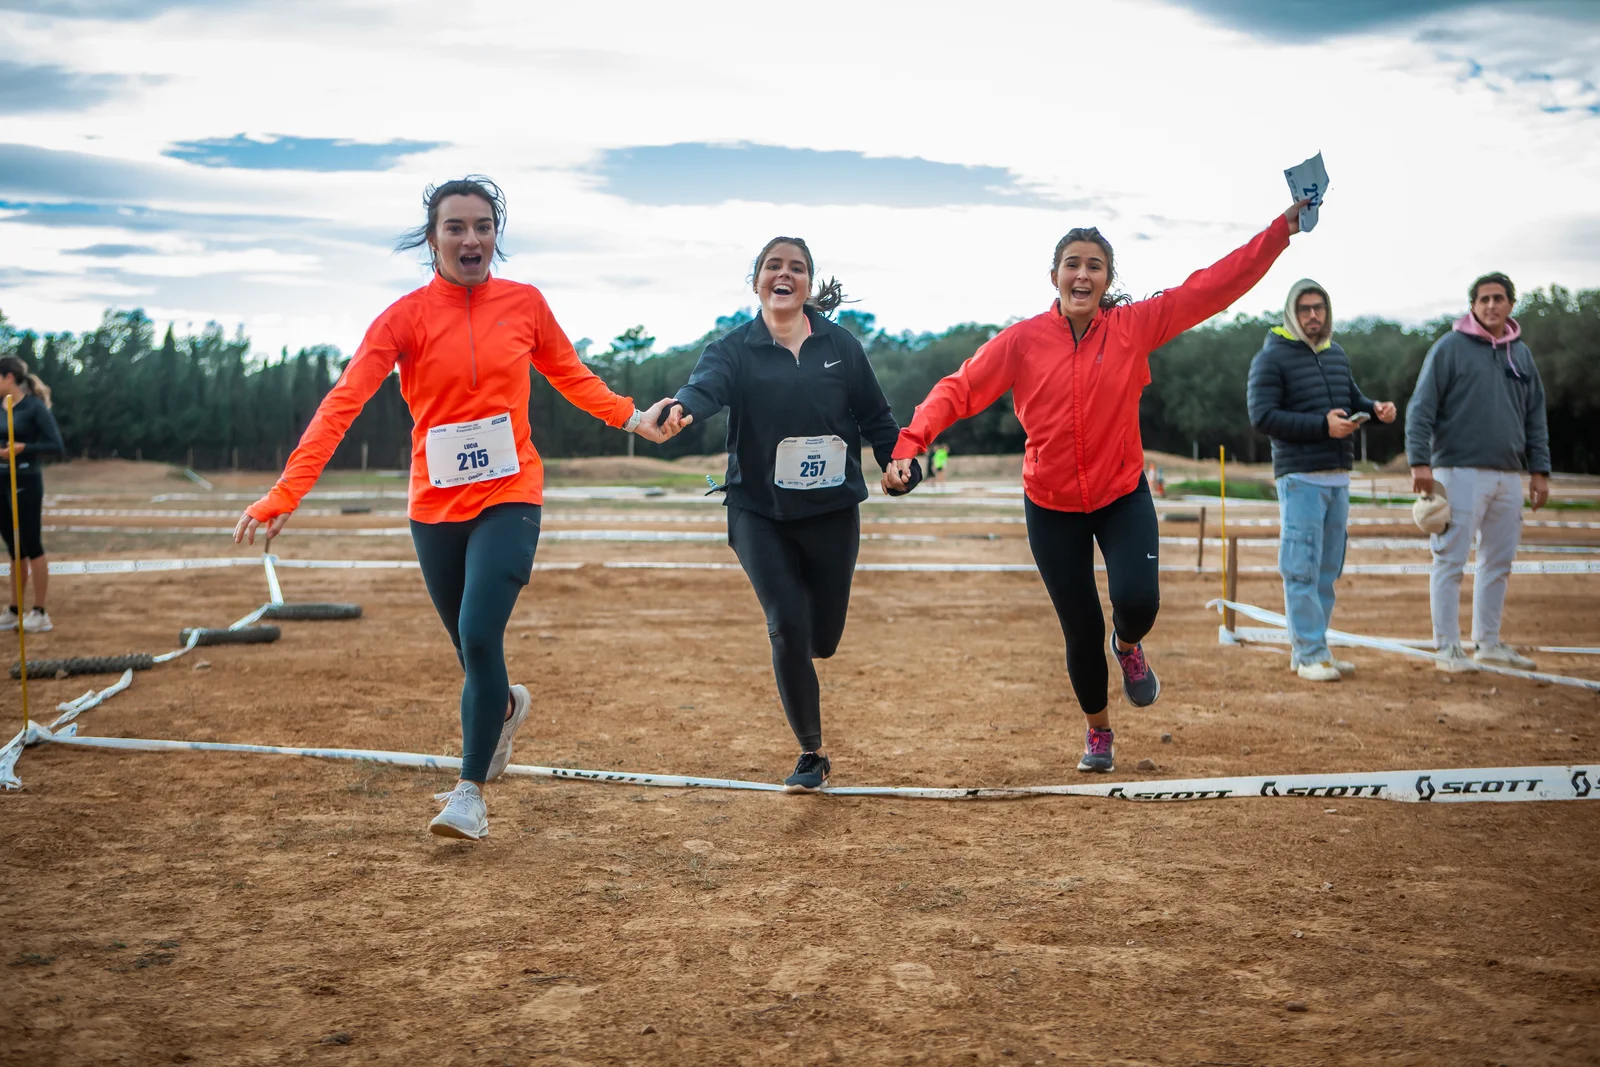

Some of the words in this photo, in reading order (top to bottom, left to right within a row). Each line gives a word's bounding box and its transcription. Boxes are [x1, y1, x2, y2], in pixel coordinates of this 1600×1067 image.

[456, 448, 489, 471] 215
[800, 460, 826, 477] 257
[1286, 784, 1388, 797] SCOTT
[1438, 779, 1543, 795] SCOTT
